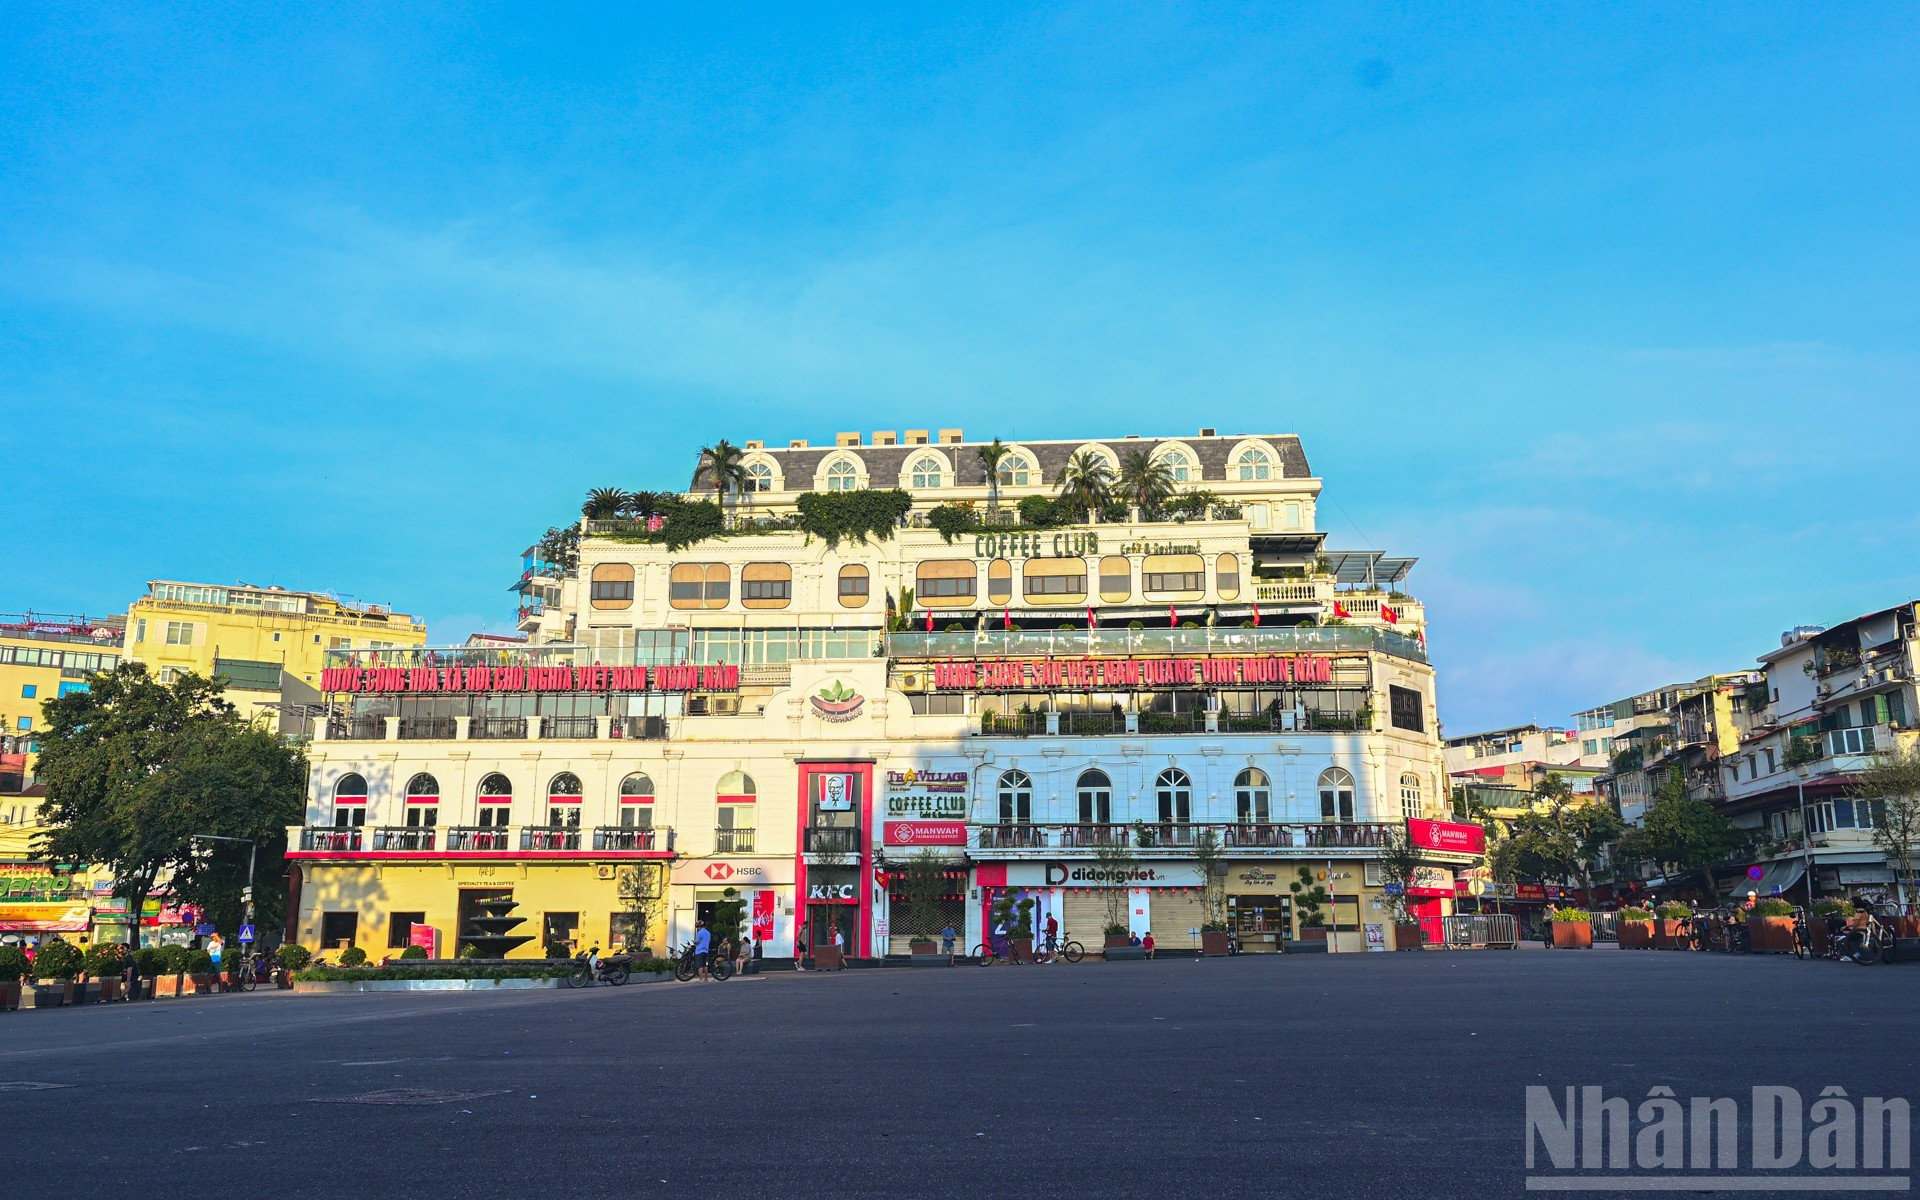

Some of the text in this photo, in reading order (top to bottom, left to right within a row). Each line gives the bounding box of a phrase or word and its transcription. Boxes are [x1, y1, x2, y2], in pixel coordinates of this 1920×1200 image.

[975, 532, 1098, 558] COFFEE CLUB
[365, 661, 406, 696] CỘNG
[465, 660, 491, 696] HỘI
[527, 661, 573, 691] NGHĨA
[577, 660, 610, 695] VIỆT
[611, 666, 647, 690] NAM
[653, 660, 698, 690] MUÔN
[703, 660, 739, 690] NĂM
[983, 656, 1024, 691] CỘNG
[1031, 653, 1063, 686] SẢN
[1067, 655, 1099, 690] VIỆT
[1103, 660, 1139, 686] NAM
[1143, 659, 1196, 687] QUANG
[1201, 658, 1239, 683] VINH
[1242, 651, 1289, 683] MUÔN
[1293, 651, 1331, 683] NĂM
[889, 796, 965, 811] COFFEE CLUB
[1441, 830, 1467, 839] MANWAH
[736, 867, 761, 875] HSBC
[810, 884, 853, 899] KFC
